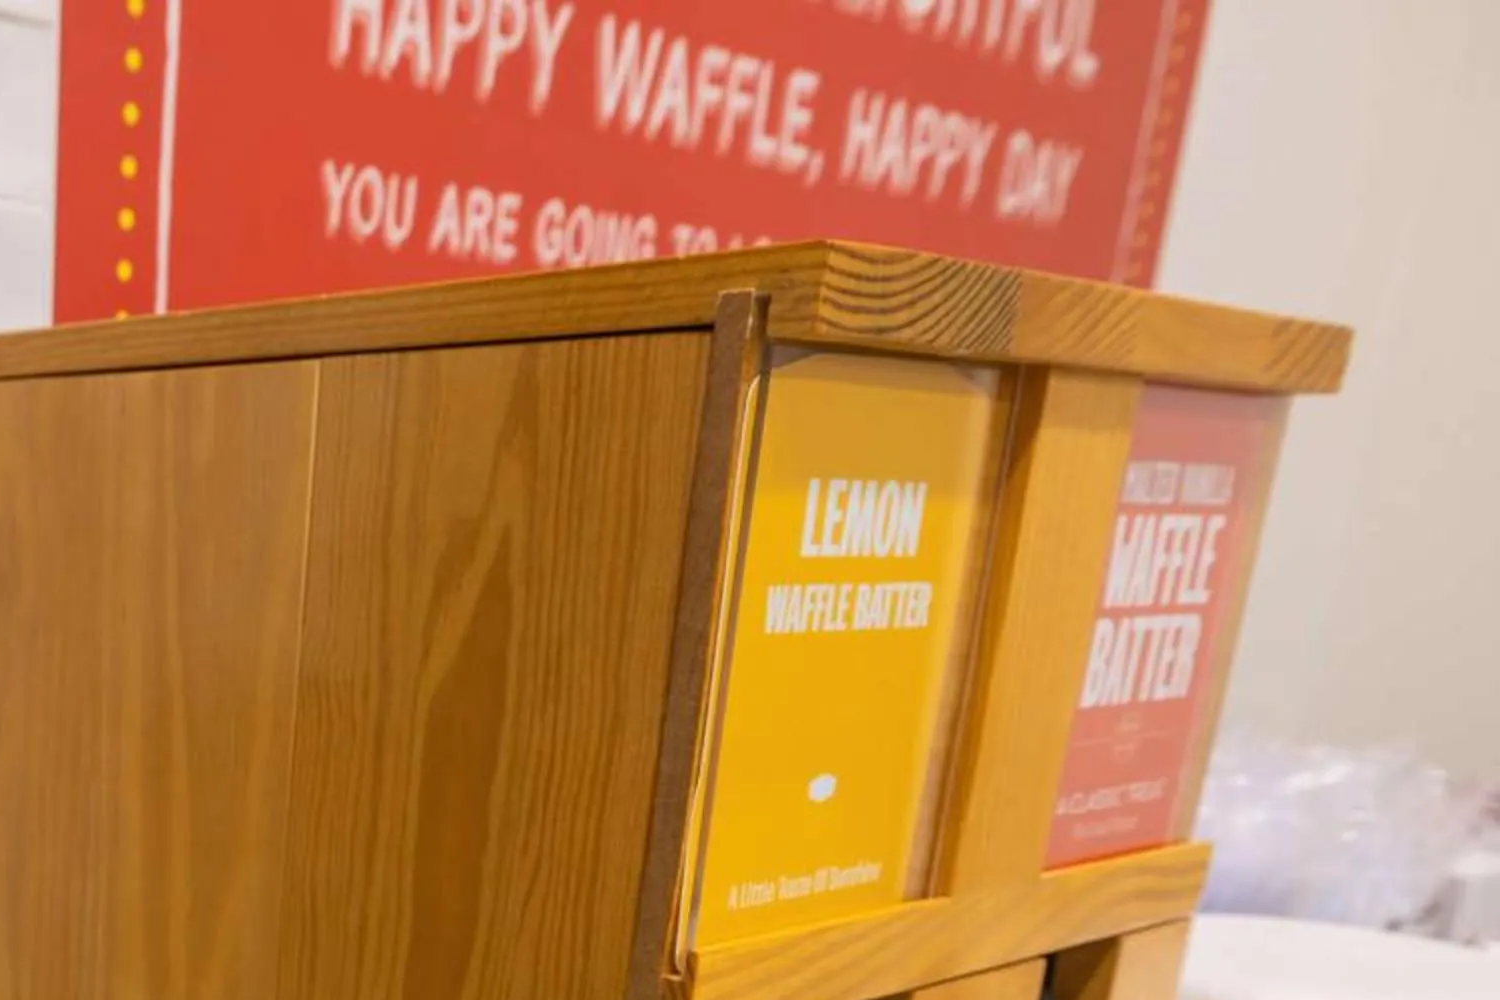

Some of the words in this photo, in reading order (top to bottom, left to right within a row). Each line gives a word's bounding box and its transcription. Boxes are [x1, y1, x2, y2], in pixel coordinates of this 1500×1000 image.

[328, 0, 575, 115] HAPPY
[596, 13, 825, 187] WAFFLE,
[840, 89, 998, 210] HAPPY
[998, 129, 1083, 224] DAY
[321, 159, 418, 252] YOU
[429, 181, 522, 265] ARE
[534, 197, 657, 267] GOING
[800, 478, 928, 558] LEMON
[1104, 513, 1227, 608] WAFFLE
[765, 584, 853, 634] WAFFLE
[853, 581, 932, 630] BATTER
[1079, 613, 1202, 708] BATTER
